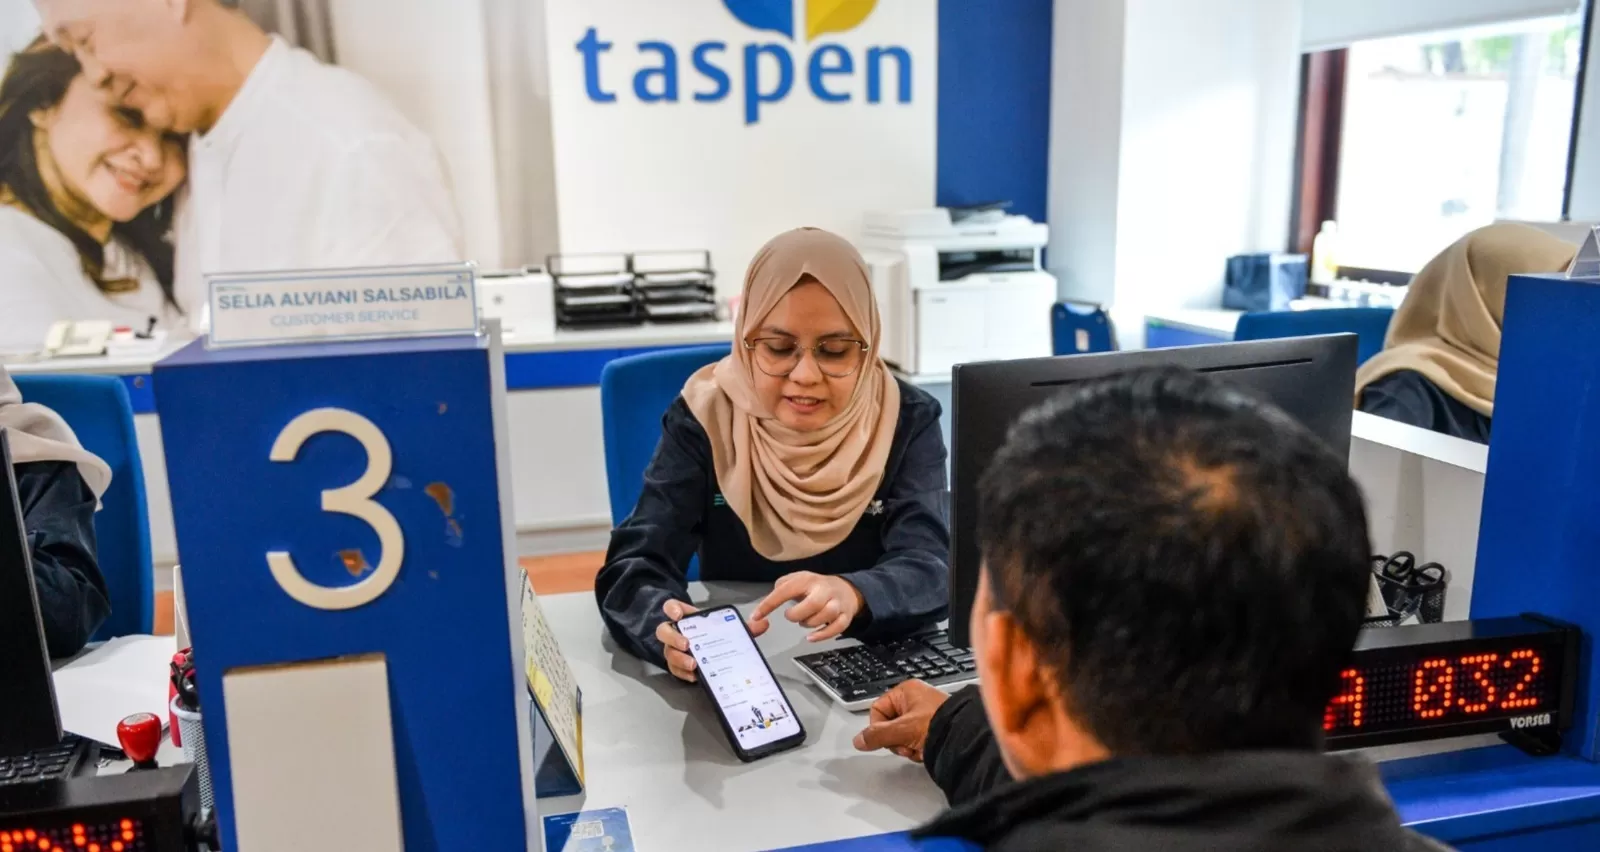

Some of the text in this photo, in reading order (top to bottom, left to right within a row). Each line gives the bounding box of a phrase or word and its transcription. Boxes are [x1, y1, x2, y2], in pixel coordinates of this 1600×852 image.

[575, 26, 913, 126] taspen
[218, 285, 468, 311] SELIA ALVIANI SALSABILA
[269, 308, 420, 328] CUSTOMER SERVICE
[266, 407, 405, 610] 3
[1413, 648, 1542, 719] 032
